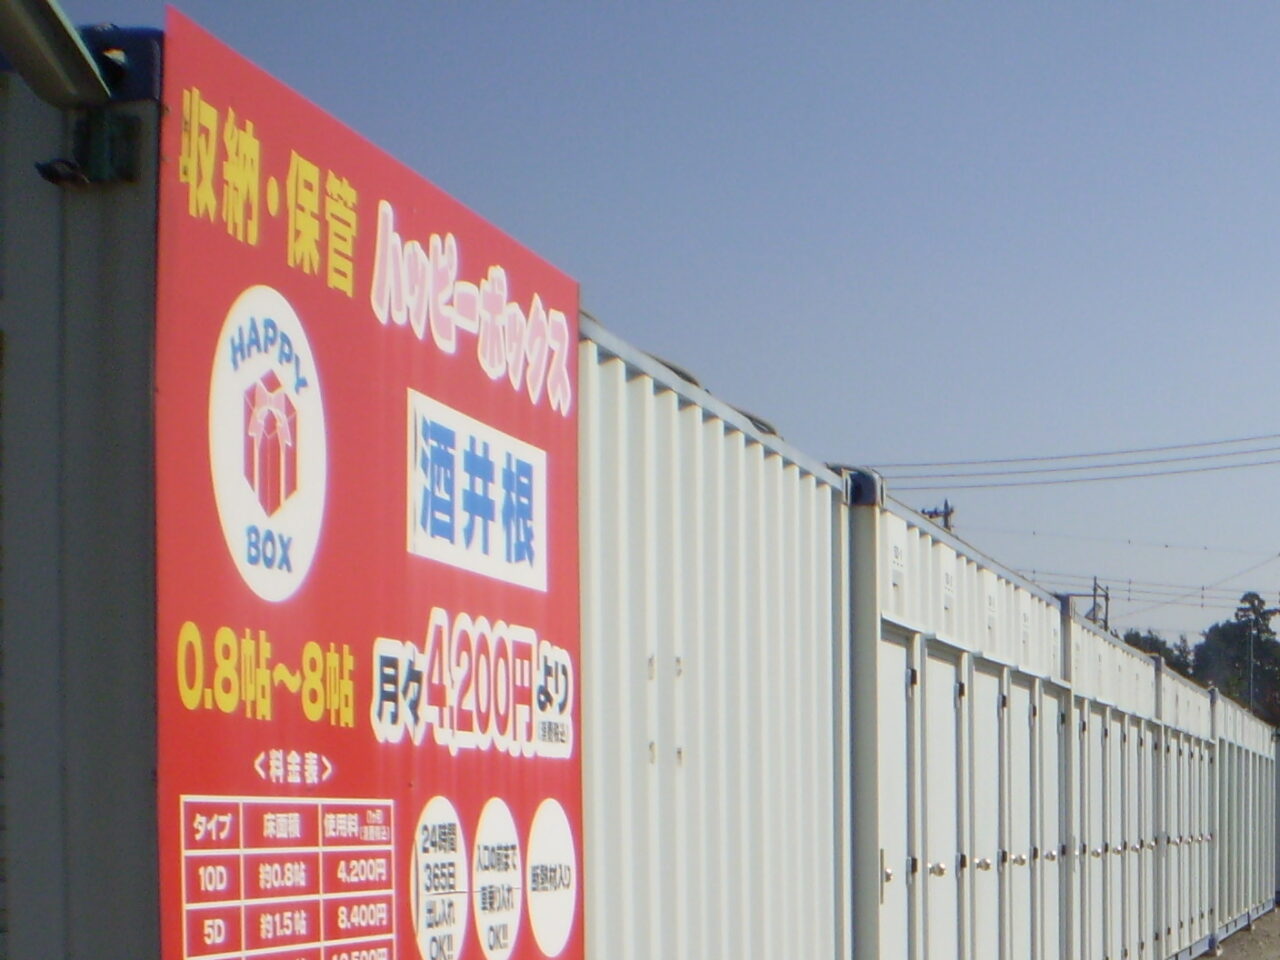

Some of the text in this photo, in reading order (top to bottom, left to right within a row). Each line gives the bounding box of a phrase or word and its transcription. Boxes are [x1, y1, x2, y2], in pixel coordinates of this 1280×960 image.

[180, 87, 357, 298] 収納・保管
[371, 200, 571, 416] ハッピーボックス
[231, 317, 308, 393] HAPPY
[420, 415, 535, 568] 酒井根
[246, 525, 293, 573] BOX
[193, 813, 232, 840] タイプ
[422, 823, 457, 854] 24時間
[198, 865, 228, 892] 10D
[424, 862, 456, 892] 365日
[204, 918, 225, 945] 5D
